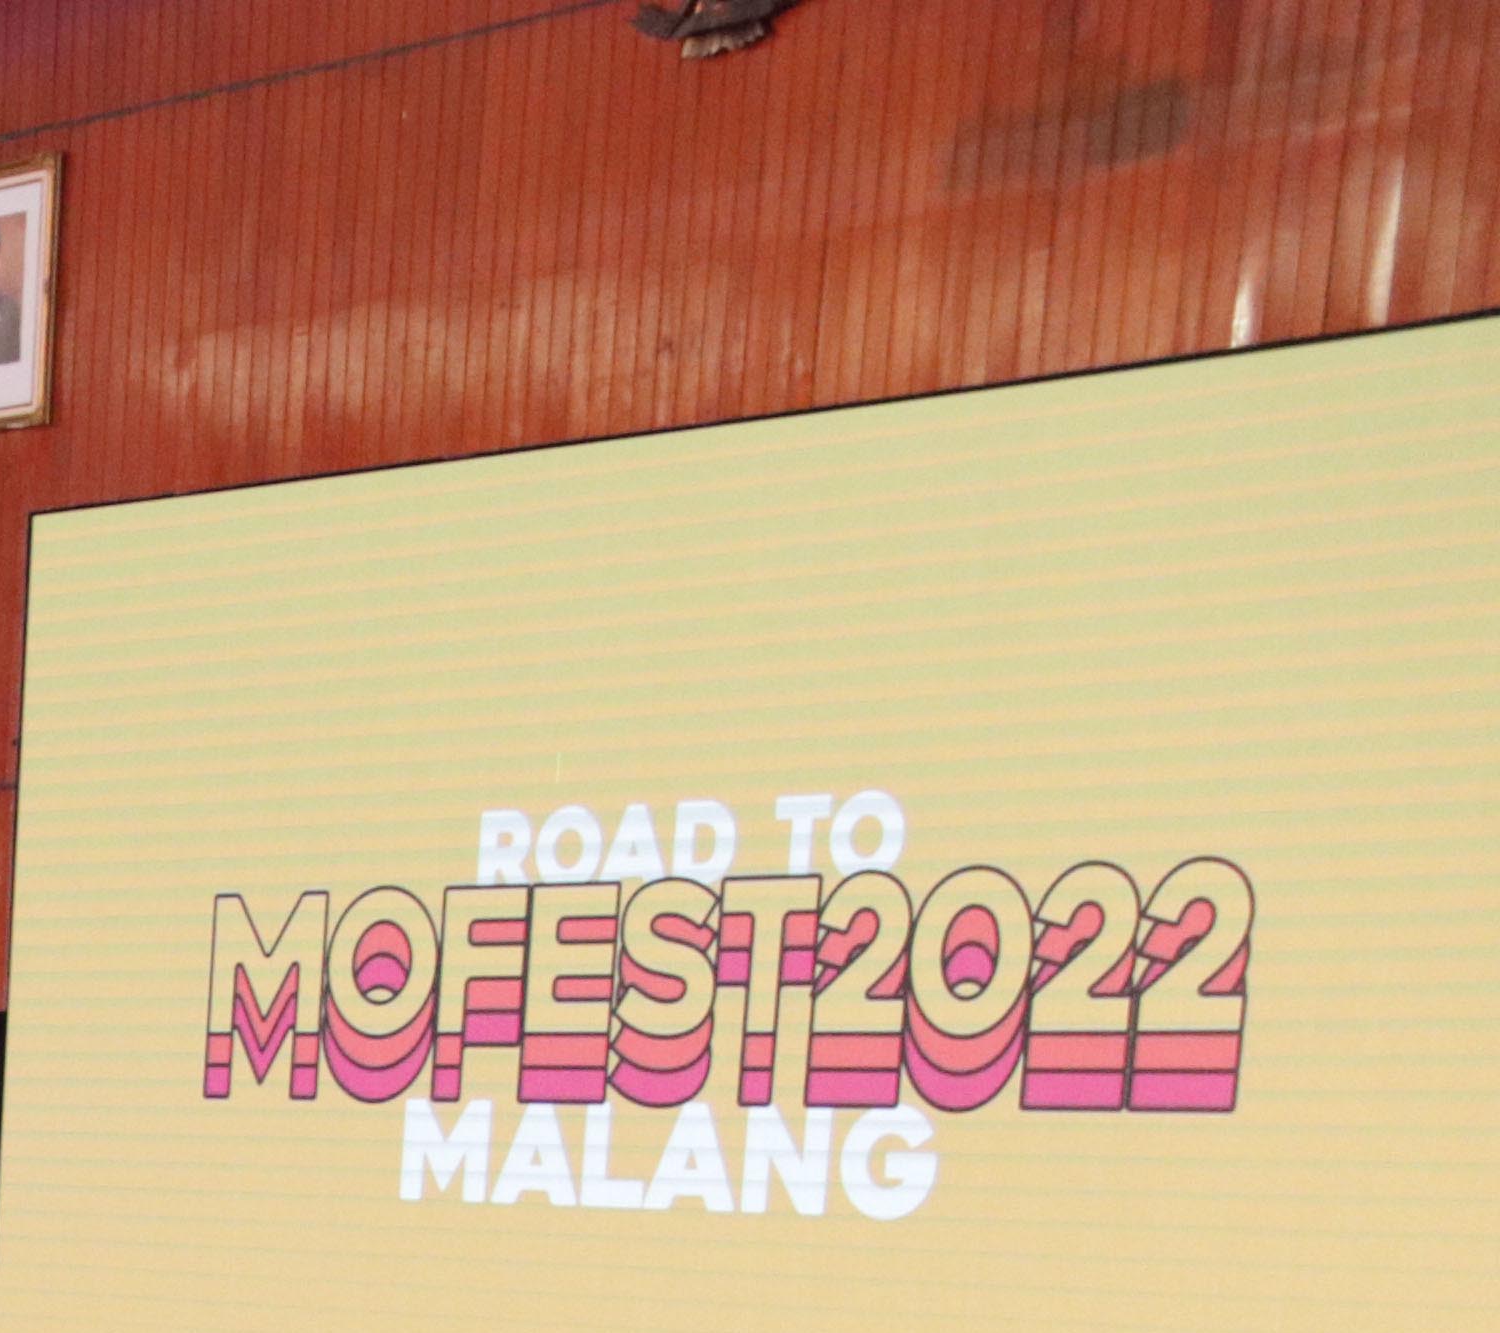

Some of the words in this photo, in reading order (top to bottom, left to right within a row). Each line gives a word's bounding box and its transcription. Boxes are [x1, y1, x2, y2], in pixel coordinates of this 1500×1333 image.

[476, 799, 737, 886] ROAD
[775, 789, 906, 879] TO
[203, 857, 1257, 1112] MOFEST2022
[398, 1099, 938, 1219] MALANG
